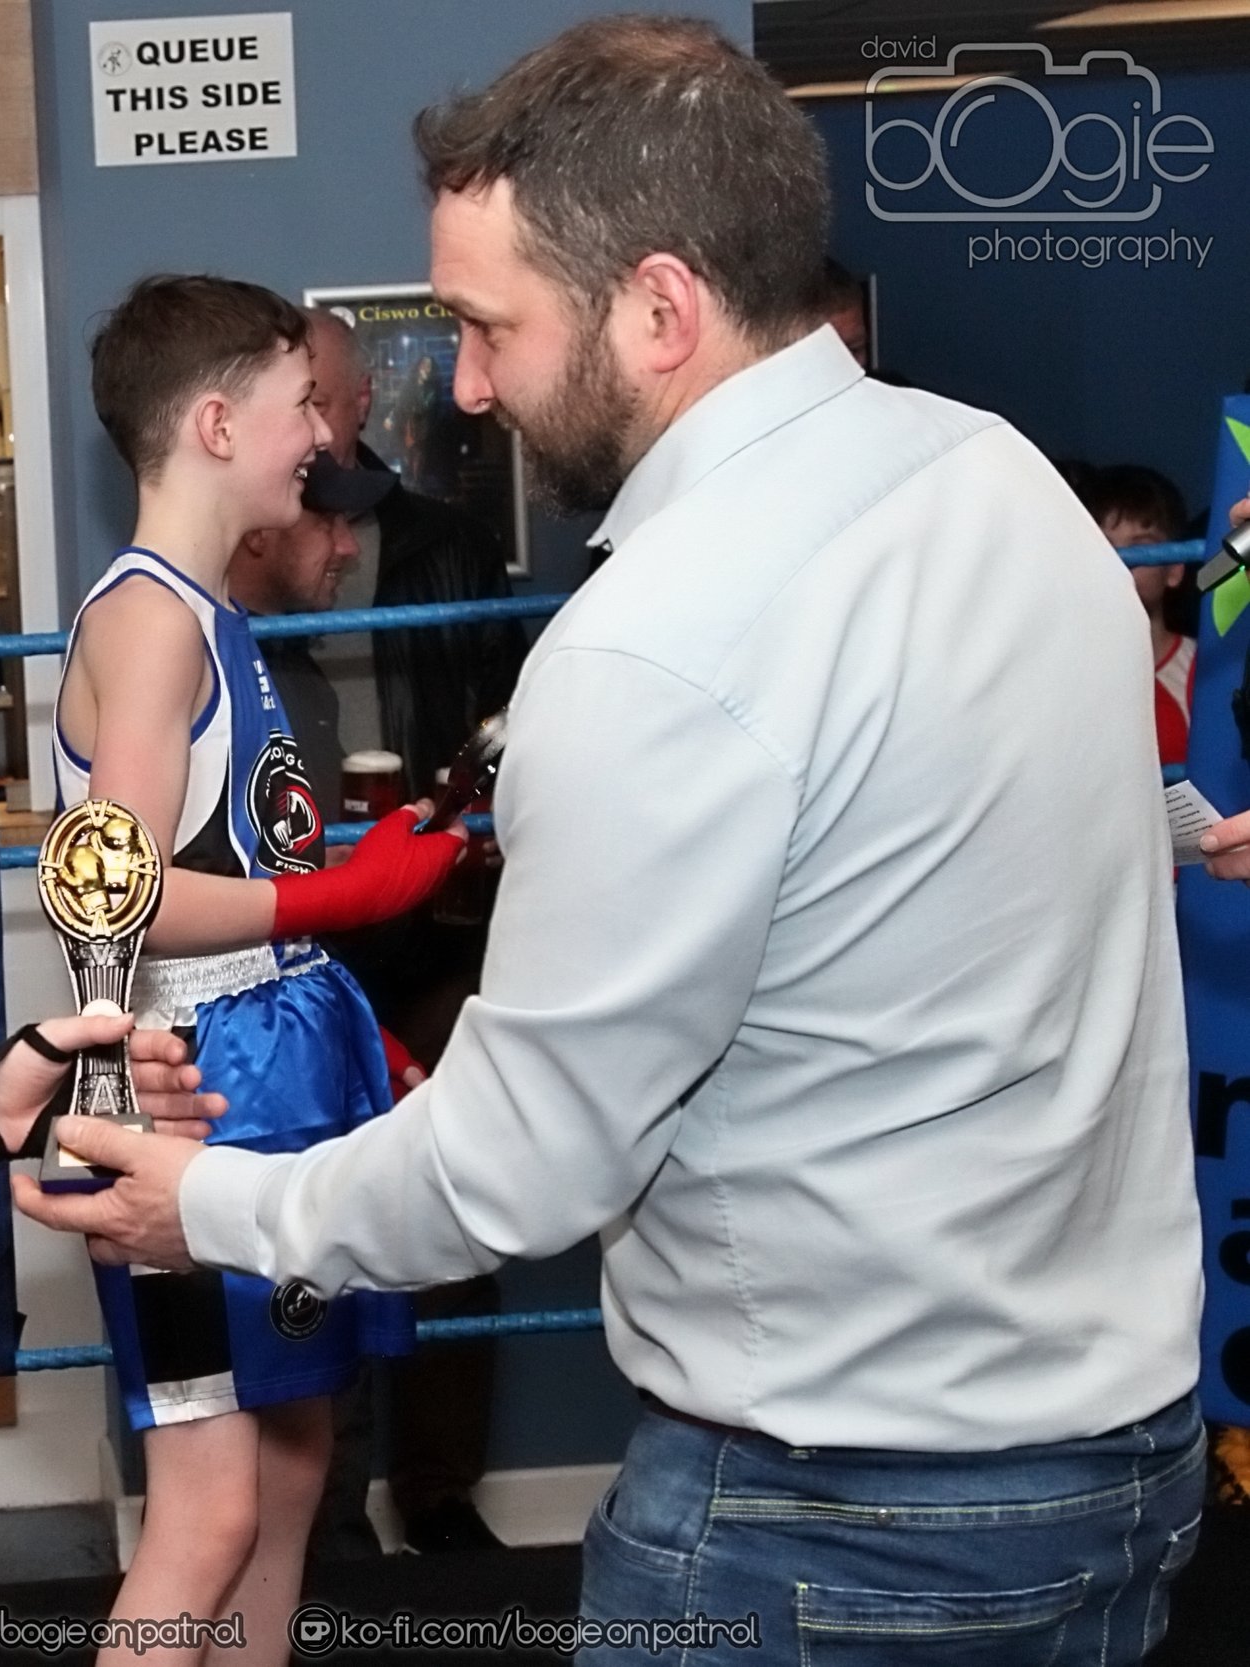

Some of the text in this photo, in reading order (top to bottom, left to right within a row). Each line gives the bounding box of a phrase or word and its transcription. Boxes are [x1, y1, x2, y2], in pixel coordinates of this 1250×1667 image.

[136, 36, 259, 66] QUEUE
[106, 81, 282, 113] THIS SIDE
[134, 127, 269, 157] PLEASE
[359, 303, 456, 322] Ciswo Cl
[276, 860, 312, 875] FIGH
